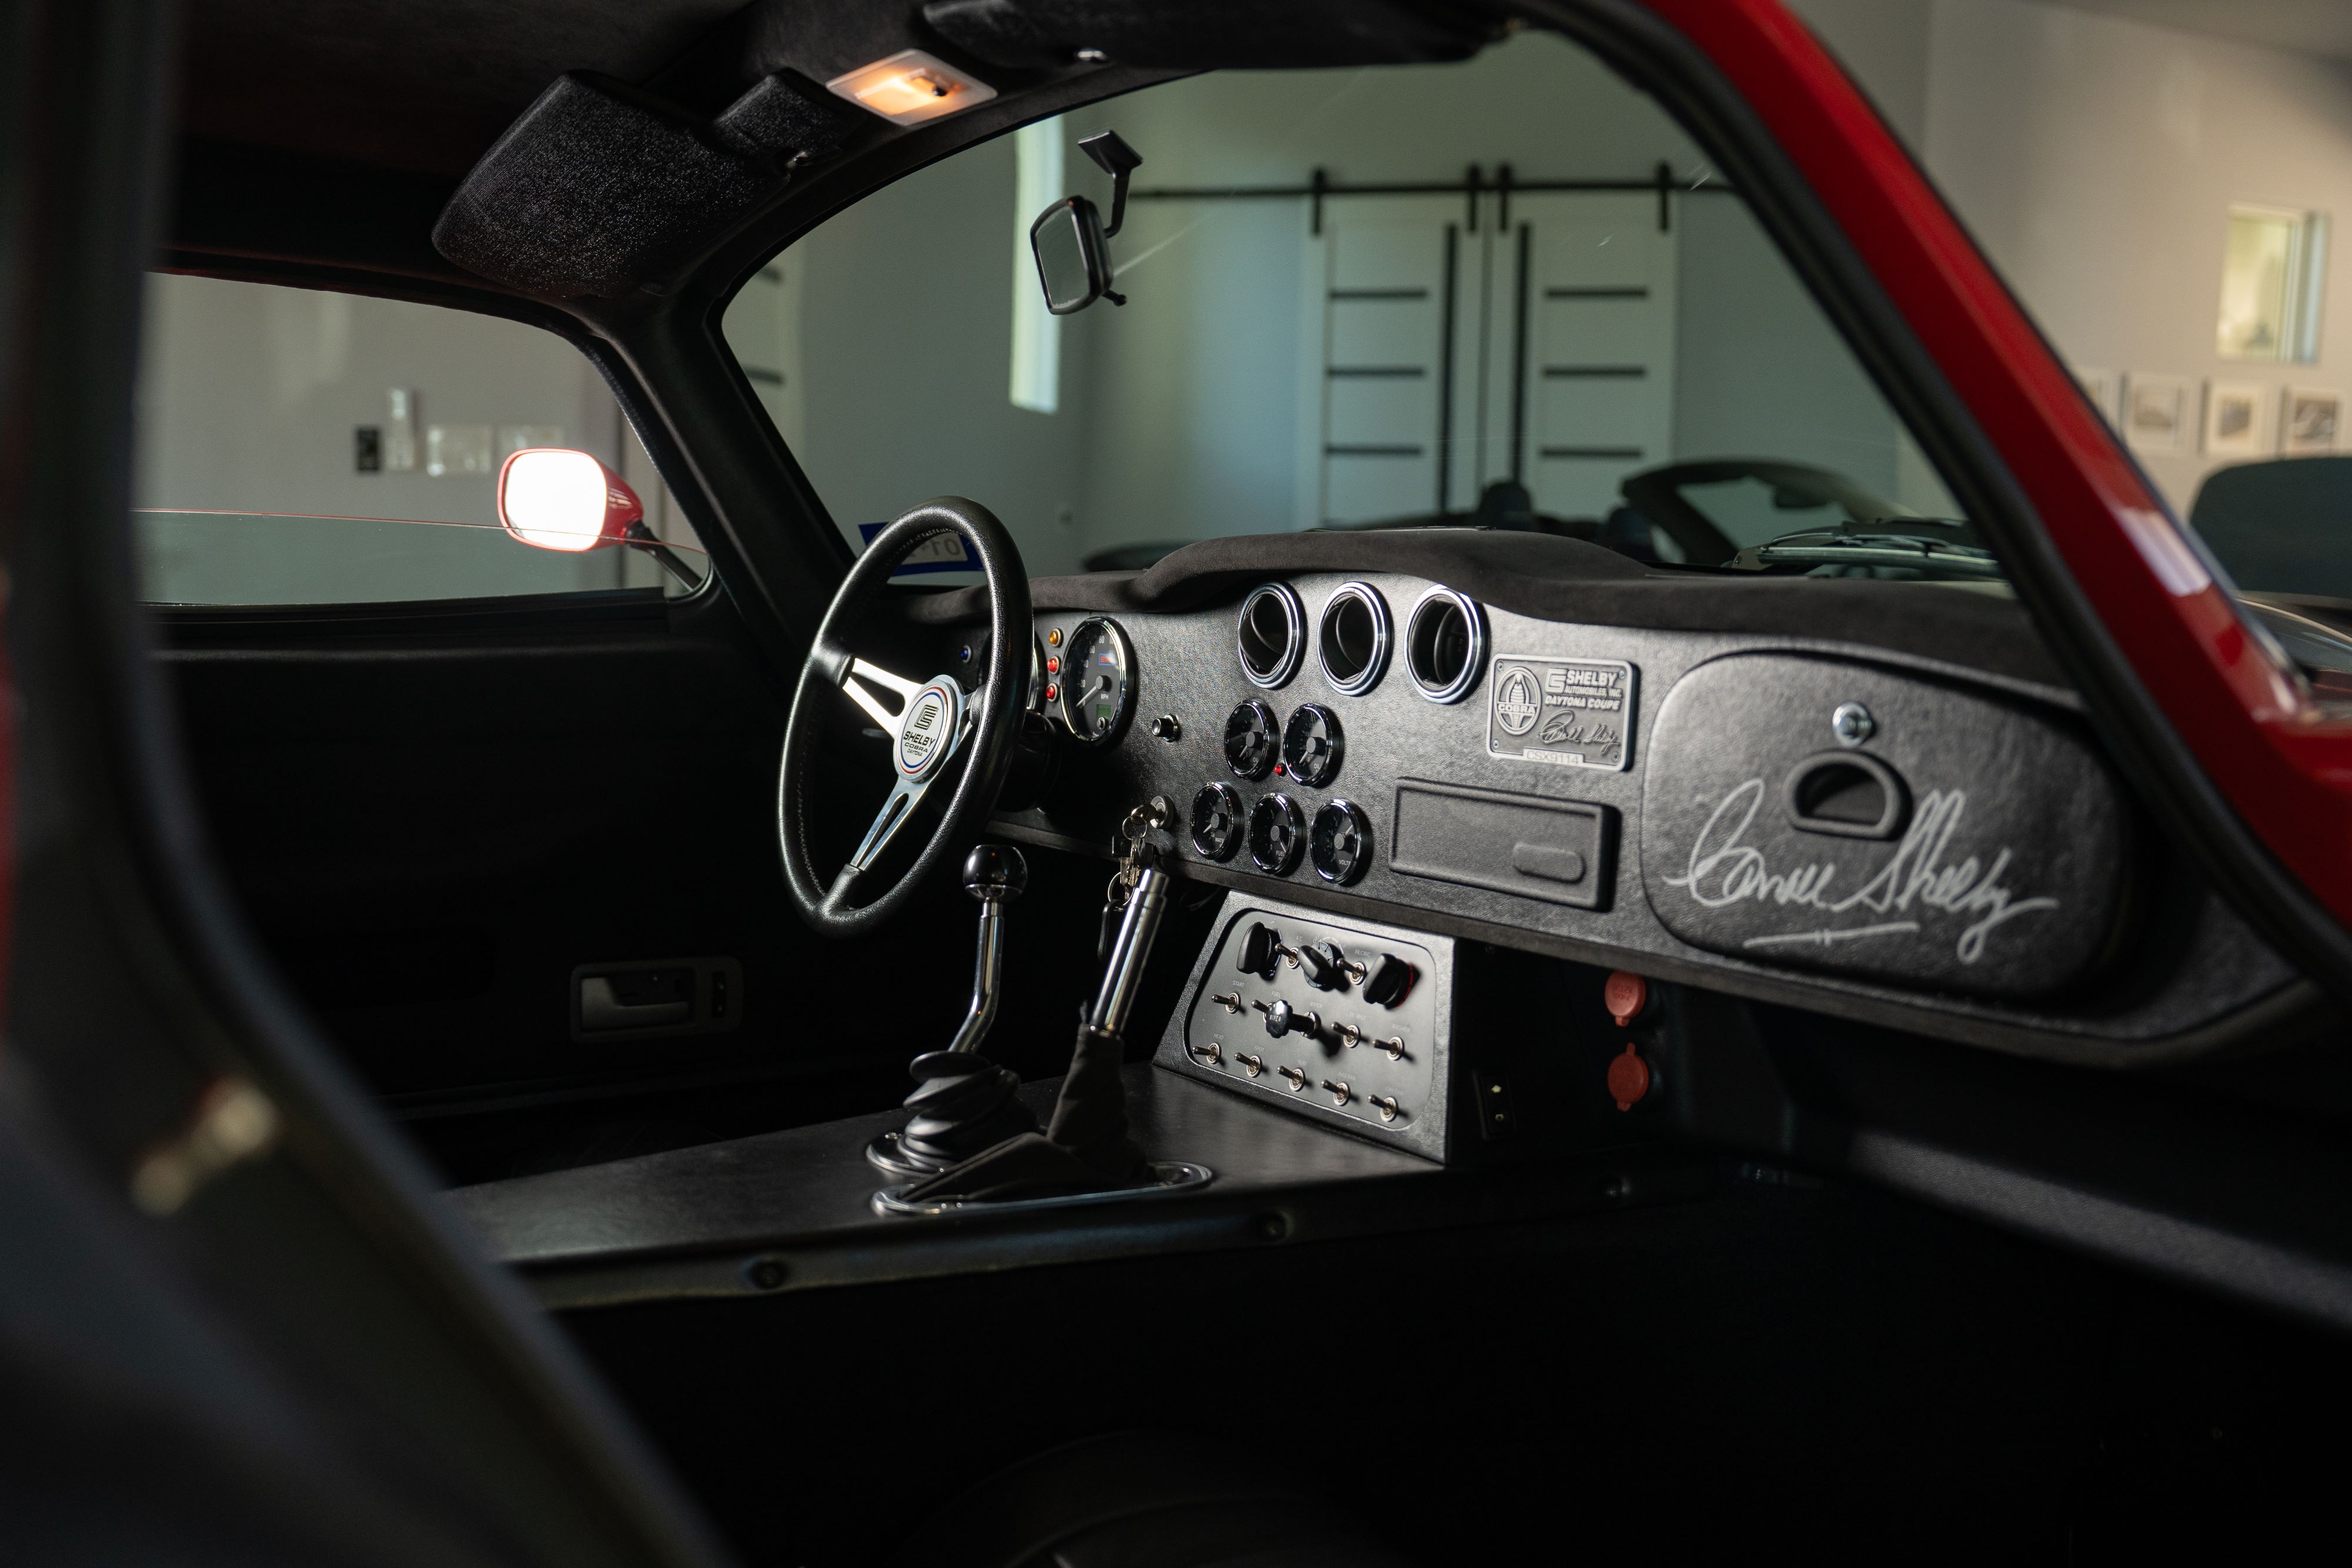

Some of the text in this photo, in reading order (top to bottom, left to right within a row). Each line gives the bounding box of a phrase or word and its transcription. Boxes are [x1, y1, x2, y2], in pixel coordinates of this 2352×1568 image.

[1098, 635, 1105, 644] 80
[1566, 669, 1618, 687] SHELBY
[1564, 686, 1608, 697] AUTOMOBILES,
[1498, 703, 1536, 713] COBRA
[1545, 695, 1621, 711] DAYTONA COUPE
[903, 731, 936, 747] SHELBY
[904, 742, 928, 753] COBRA
[907, 748, 923, 757] DAYTONA
[1526, 751, 1579, 764] CSX9114
[1355, 948, 1371, 957] RECIRC
[1269, 1014, 1282, 1022] WIPER
